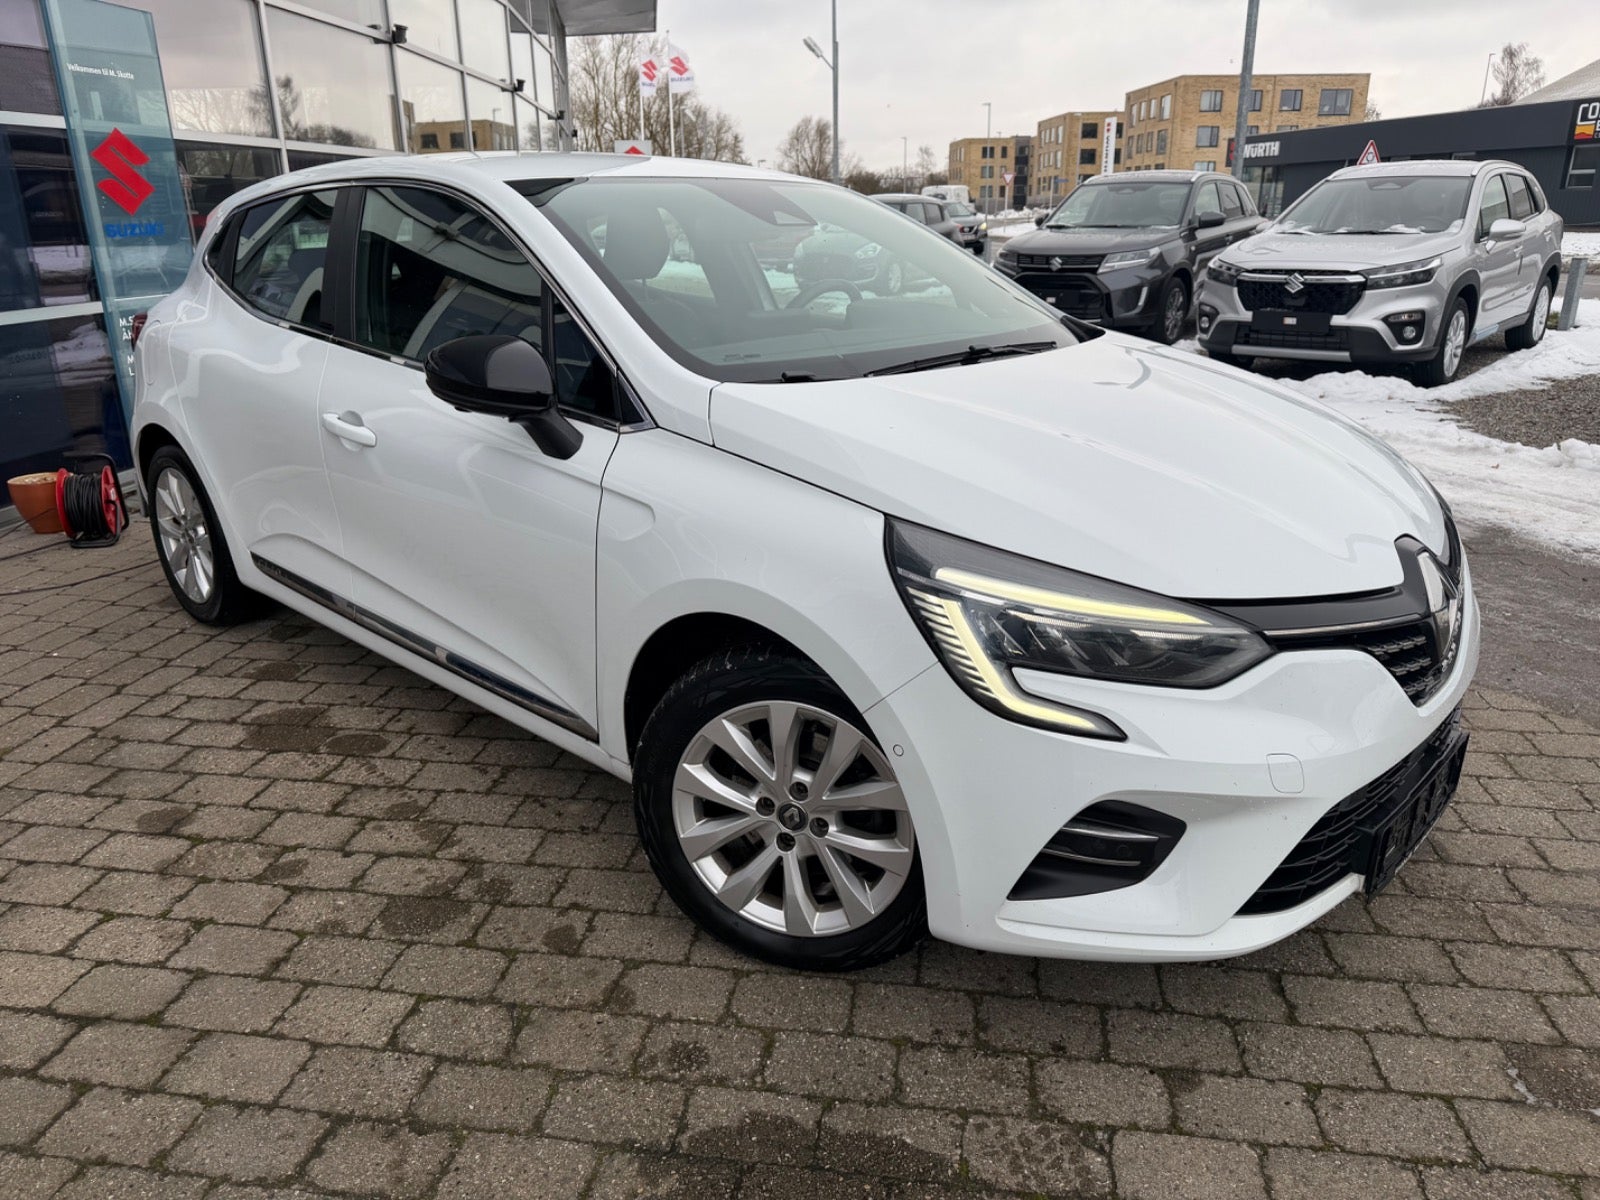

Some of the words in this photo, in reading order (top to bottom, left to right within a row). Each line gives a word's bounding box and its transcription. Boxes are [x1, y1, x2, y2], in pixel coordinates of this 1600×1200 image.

[66, 62, 101, 75] Velkommen
[101, 67, 109, 76] til
[105, 222, 166, 238] SUZUKI
